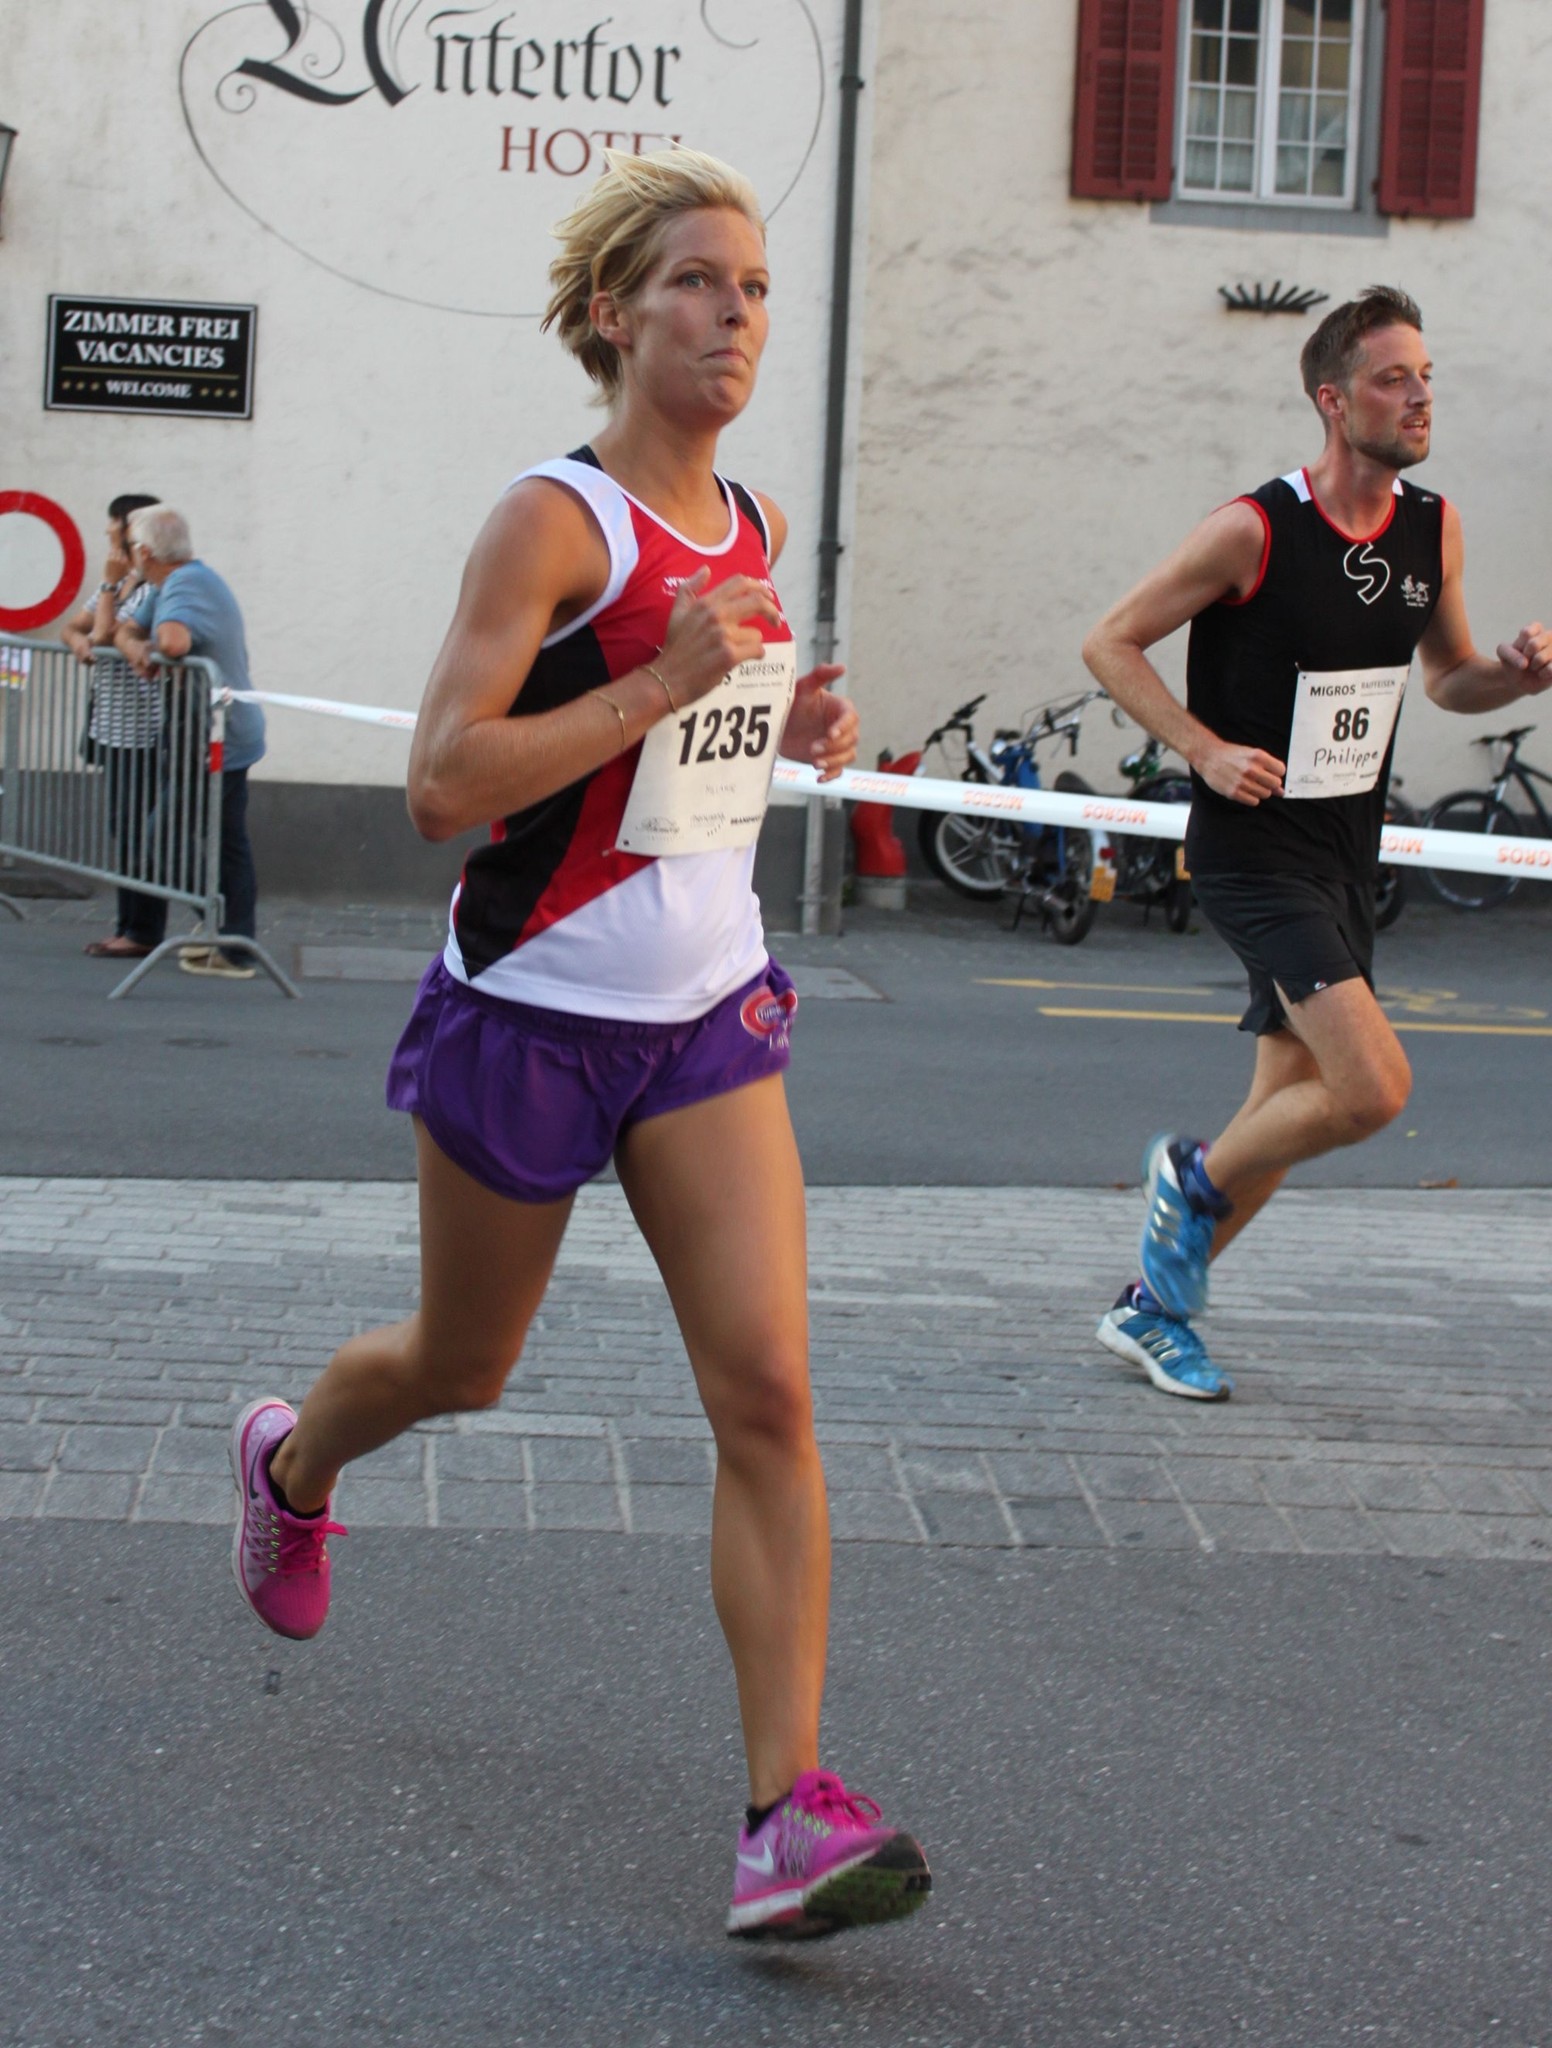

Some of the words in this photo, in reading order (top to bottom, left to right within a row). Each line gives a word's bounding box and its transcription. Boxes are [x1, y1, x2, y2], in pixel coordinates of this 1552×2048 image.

[63, 309, 175, 337] ZIMMER
[180, 316, 240, 340] FREI
[76, 340, 225, 369] VACANCIES
[105, 380, 192, 399] WELCOME
[1309, 685, 1357, 697] MIGROS
[678, 705, 772, 766] 1235
[1332, 707, 1370, 742] 86
[1313, 747, 1378, 769] Philippe
[962, 790, 1025, 812] MIGROS
[1082, 803, 1149, 826] MIGROS
[1498, 844, 1552, 868] GROS
